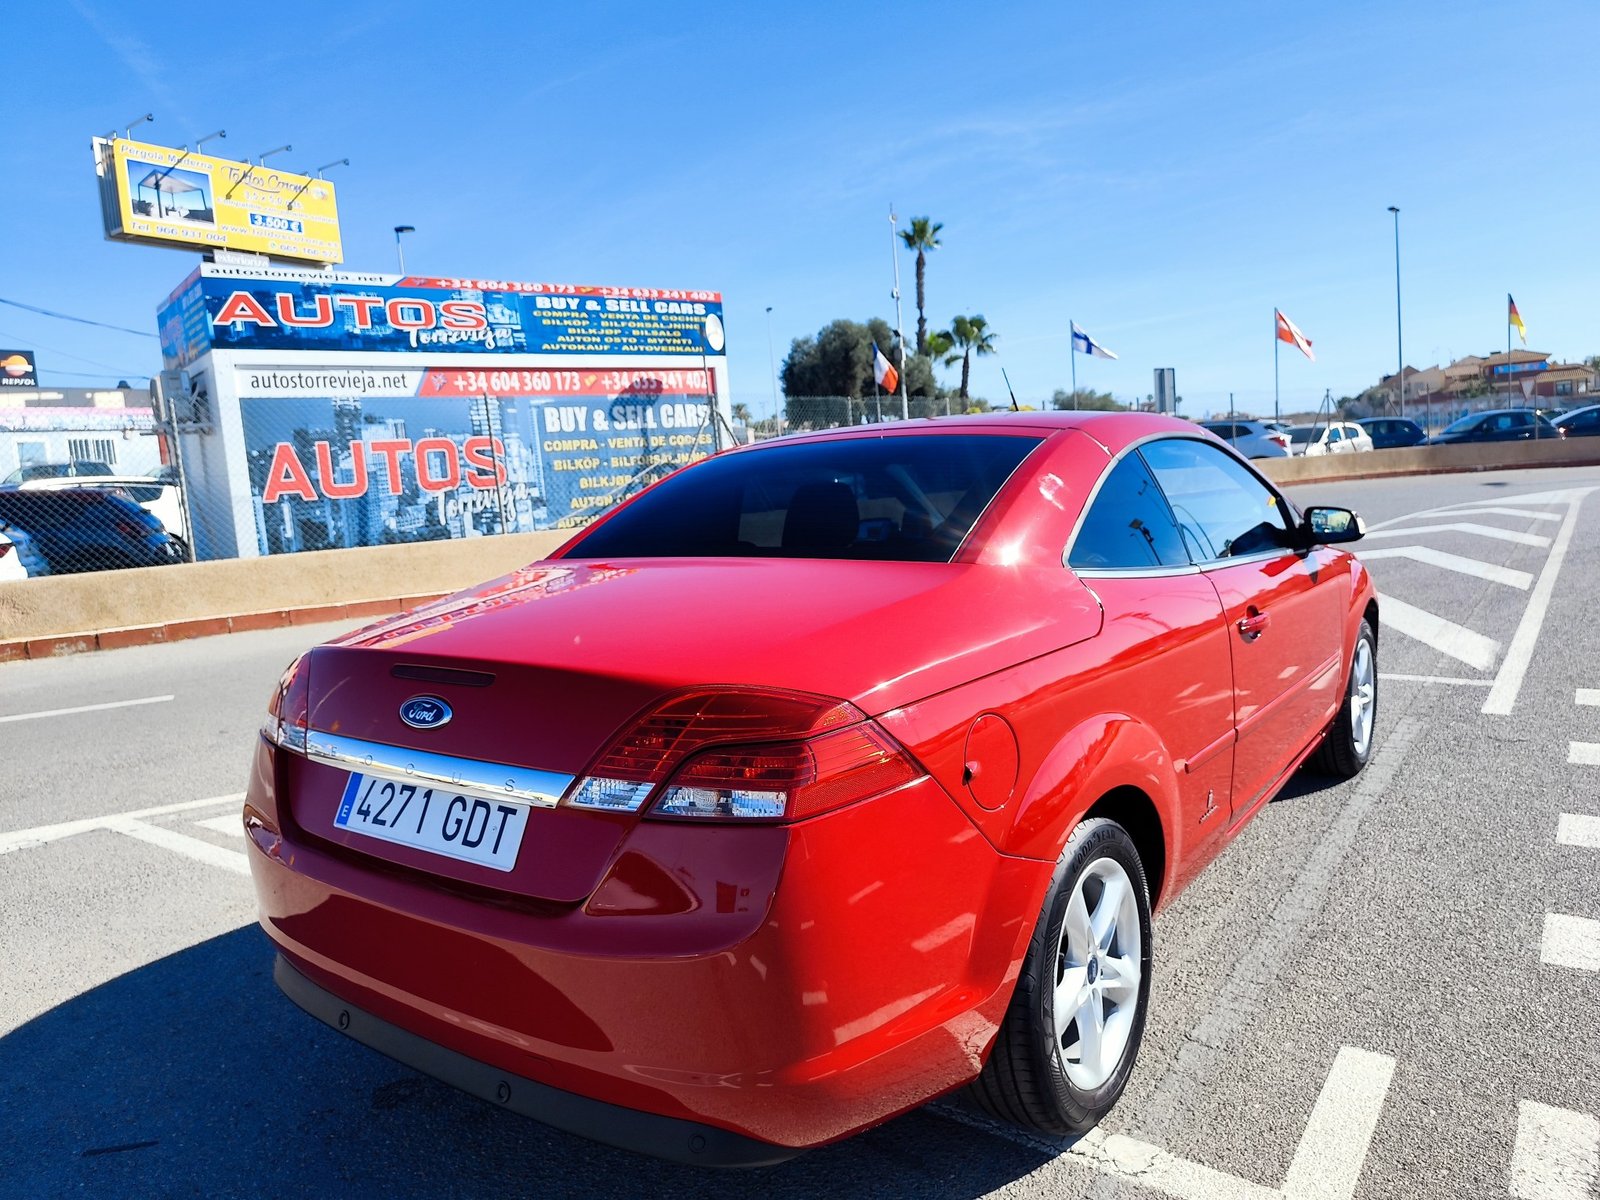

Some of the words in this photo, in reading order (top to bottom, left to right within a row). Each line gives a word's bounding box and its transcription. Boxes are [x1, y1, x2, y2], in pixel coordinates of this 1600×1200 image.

[206, 232, 227, 242] 004
[210, 267, 384, 282] autostorrevieja.net
[436, 279, 472, 289] +34
[477, 280, 509, 290] 604
[514, 282, 543, 292] 360
[547, 284, 575, 293] 173
[599, 286, 629, 297] +34
[632, 288, 658, 298] 633
[662, 289, 686, 299] 241
[690, 290, 715, 300] 402
[213, 290, 487, 332] AUTOS
[536, 296, 580, 310] BUY
[585, 299, 600, 311] &
[605, 299, 650, 313] SELL
[655, 301, 706, 315] CARS
[533, 310, 588, 319] COMPRA
[599, 311, 640, 320] VENTA
[643, 313, 659, 321] DE
[542, 343, 610, 351] AUTOKAUF
[557, 335, 601, 343] AUTON
[605, 336, 637, 344] OSTO
[647, 337, 692, 345] MYYNTI
[2, 378, 35, 386] REPSOL
[251, 370, 408, 392] autostorrevieja.net
[454, 372, 488, 391] +34
[490, 371, 519, 391] 604
[523, 371, 552, 390] 360
[556, 372, 580, 390] 173
[602, 372, 629, 390] +34
[662, 371, 683, 389] 241
[686, 371, 707, 388] 402
[544, 406, 587, 433] BUY
[593, 408, 609, 431] &
[612, 405, 657, 430] SELL
[660, 403, 711, 429] CARS
[544, 439, 598, 452] COMPRA
[608, 437, 647, 449] VENTA
[651, 435, 666, 447] DE
[668, 434, 712, 446] COCES
[263, 436, 507, 503] AUTOS
[571, 494, 613, 509] AUTON
[409, 702, 437, 721] Ford
[340, 805, 349, 818] E
[356, 779, 434, 834] 4271
[441, 796, 518, 855] GDT
